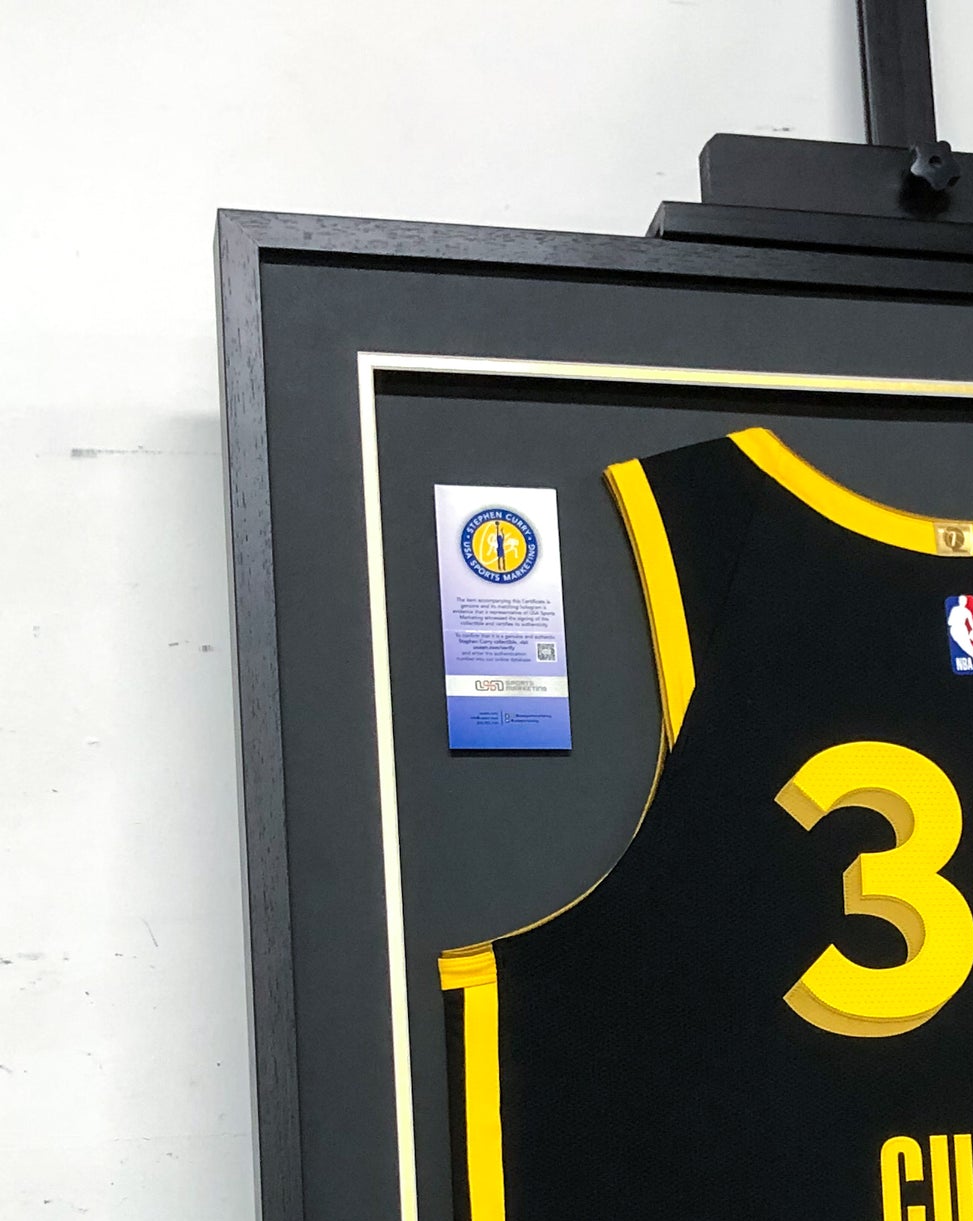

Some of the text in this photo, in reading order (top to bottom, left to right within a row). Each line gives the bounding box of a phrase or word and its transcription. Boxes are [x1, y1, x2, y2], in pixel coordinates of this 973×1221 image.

[466, 511, 531, 536] STEPHEN CURRY
[463, 541, 536, 581] USA SPORTS MARKETING
[955, 657, 973, 671] NBA
